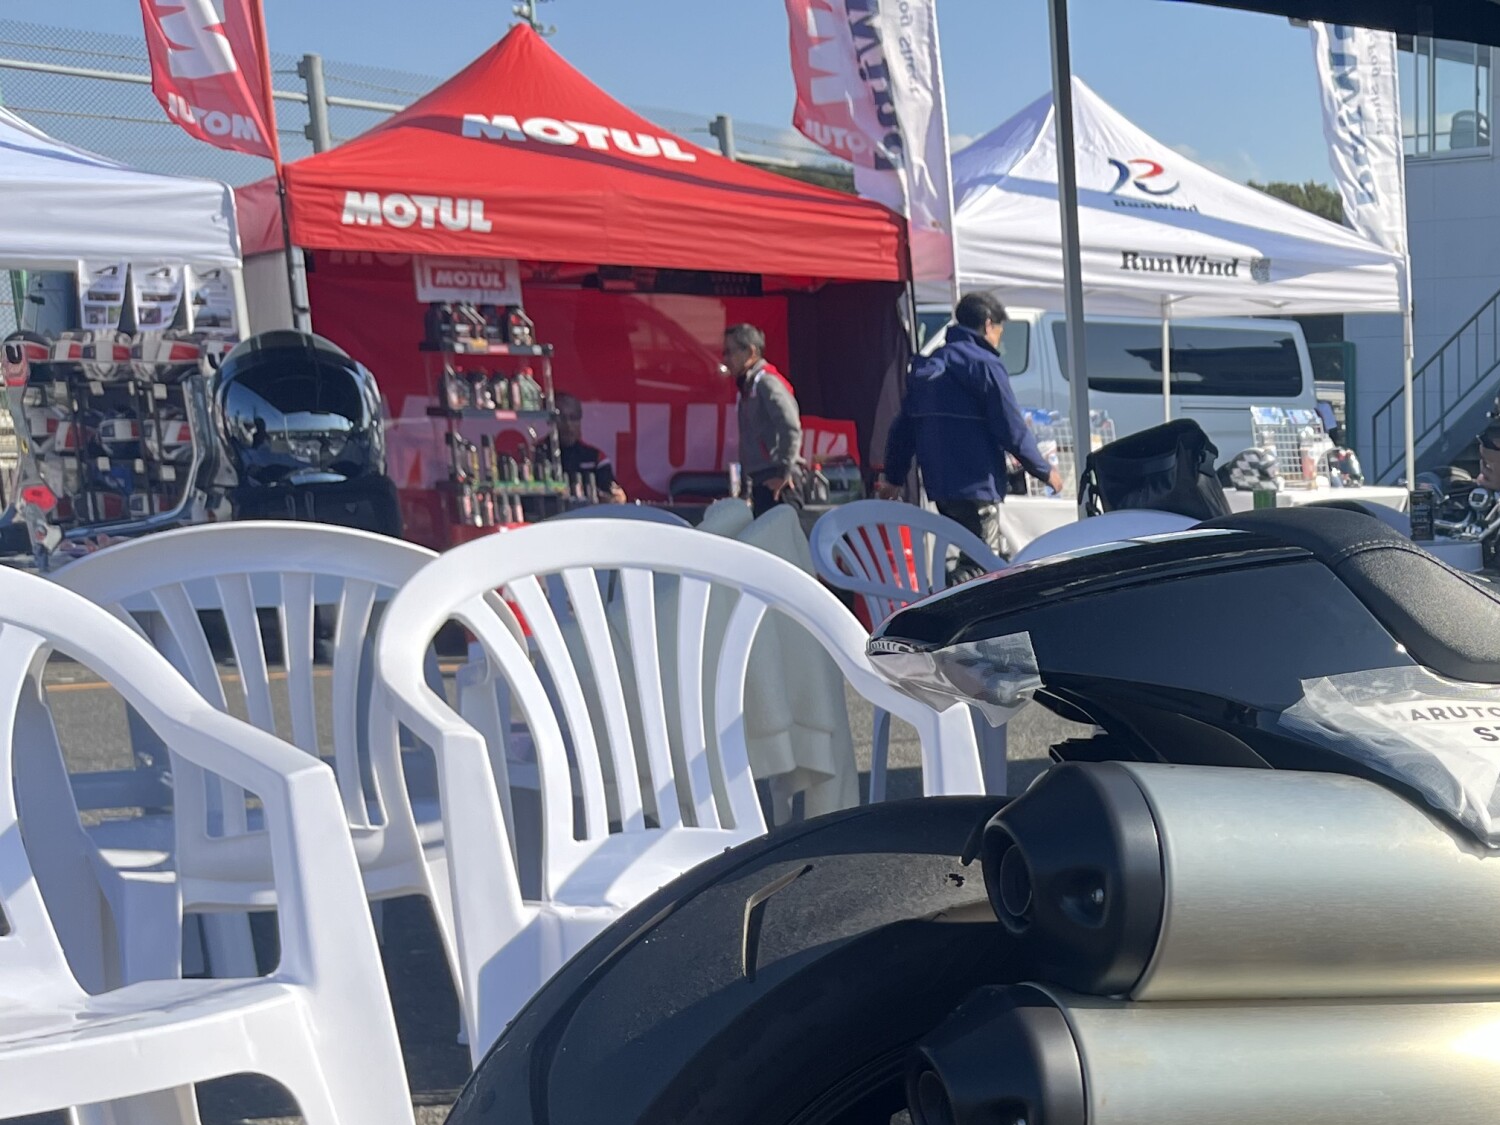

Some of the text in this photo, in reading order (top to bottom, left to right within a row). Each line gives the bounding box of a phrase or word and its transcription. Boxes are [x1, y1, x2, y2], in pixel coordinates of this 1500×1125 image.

[462, 113, 697, 162] MOTUL
[342, 190, 492, 233] MOTUL
[435, 270, 504, 288] MOTUL
[1120, 250, 1239, 277] RunWind
